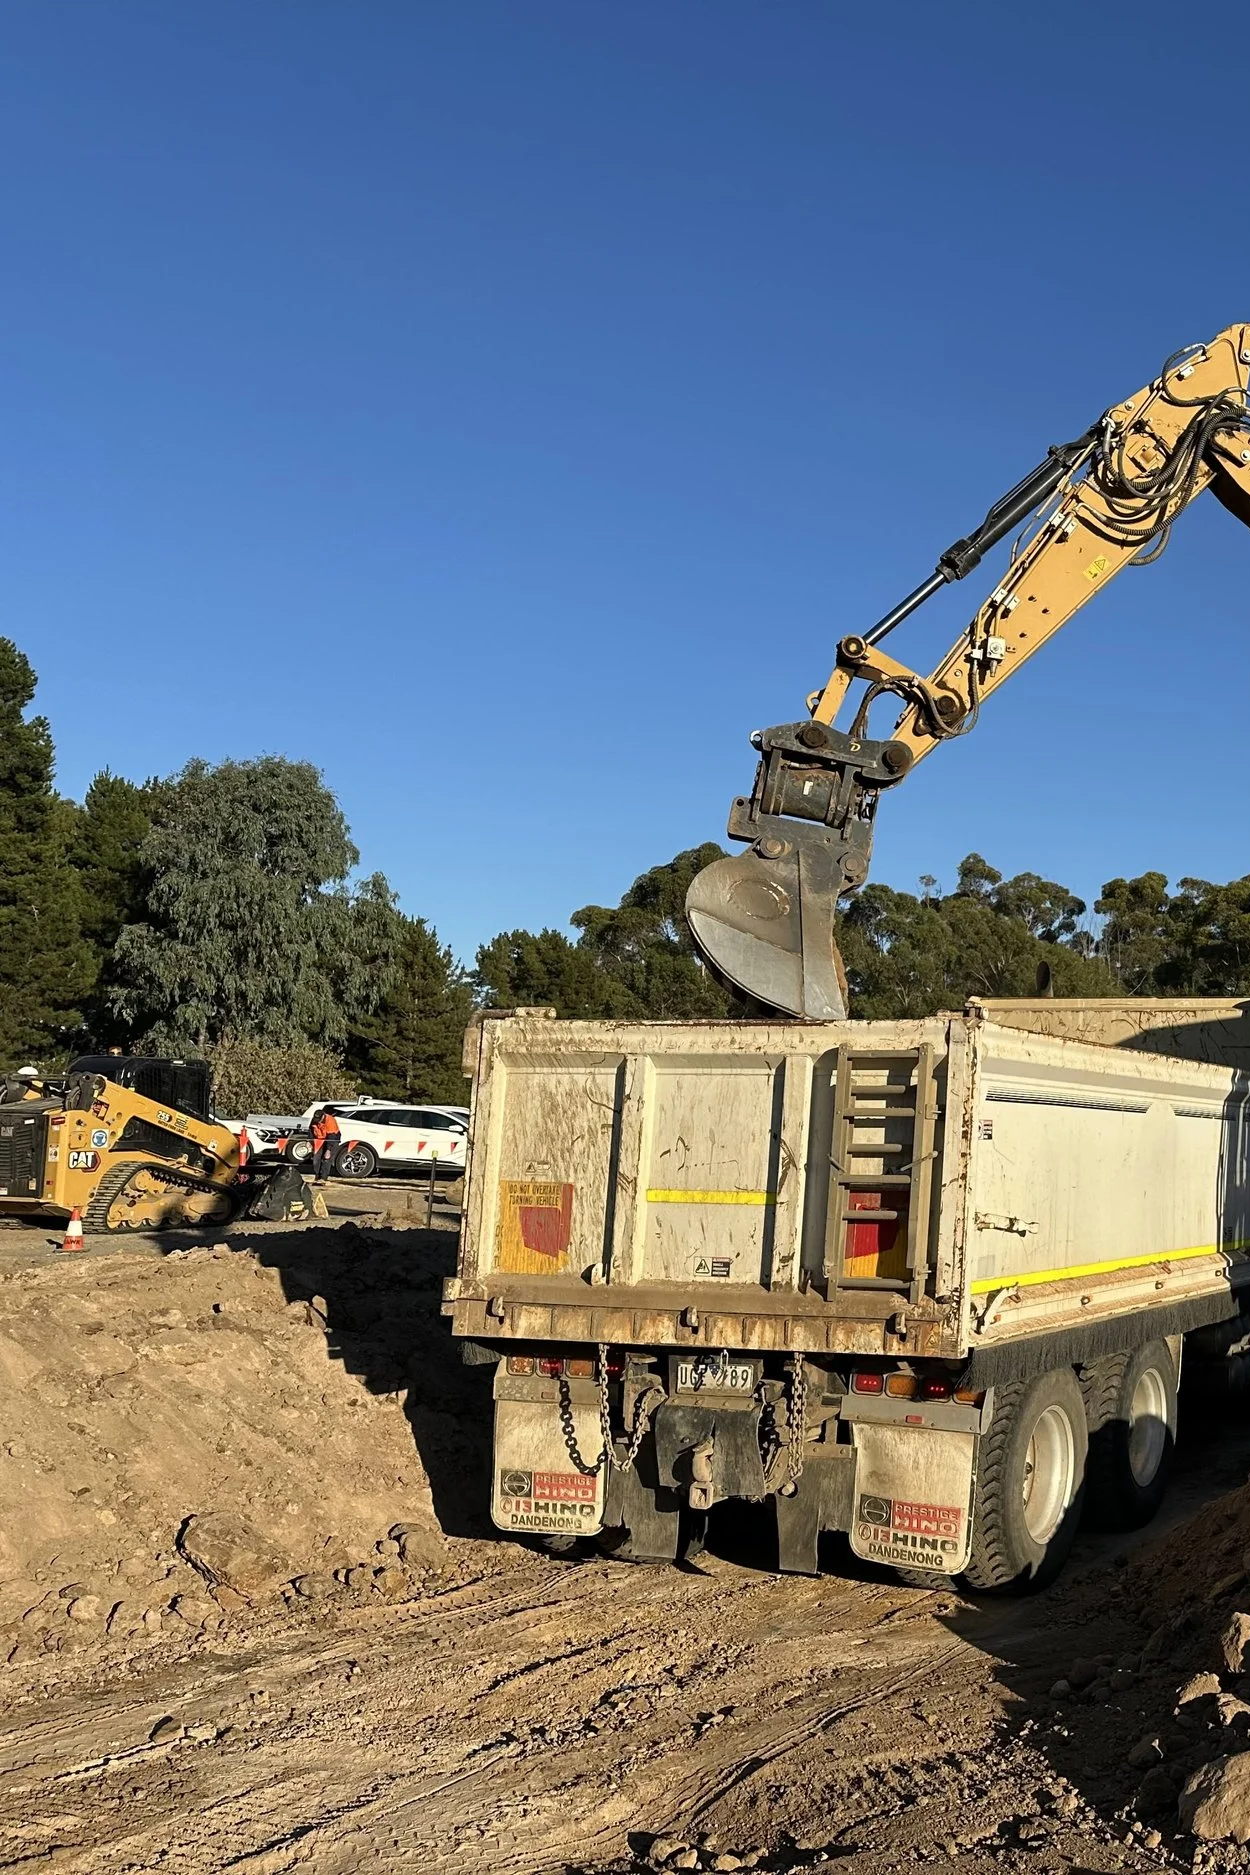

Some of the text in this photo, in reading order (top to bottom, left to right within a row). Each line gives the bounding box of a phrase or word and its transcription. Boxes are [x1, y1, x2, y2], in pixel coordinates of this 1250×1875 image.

[157, 1110, 171, 1122] 255
[69, 1151, 94, 1169] CAT
[509, 1183, 560, 1195] DO NOT OVERTAKE
[509, 1194, 559, 1206] TURNING VEHICLE
[535, 1474, 593, 1485] PRESTIGE
[535, 1486, 593, 1498] HINO
[895, 1504, 959, 1520] PRESTIGE
[511, 1514, 582, 1529] DANDENONG
[894, 1515, 957, 1534] HINO
[868, 1542, 943, 1566] DANDENONG
